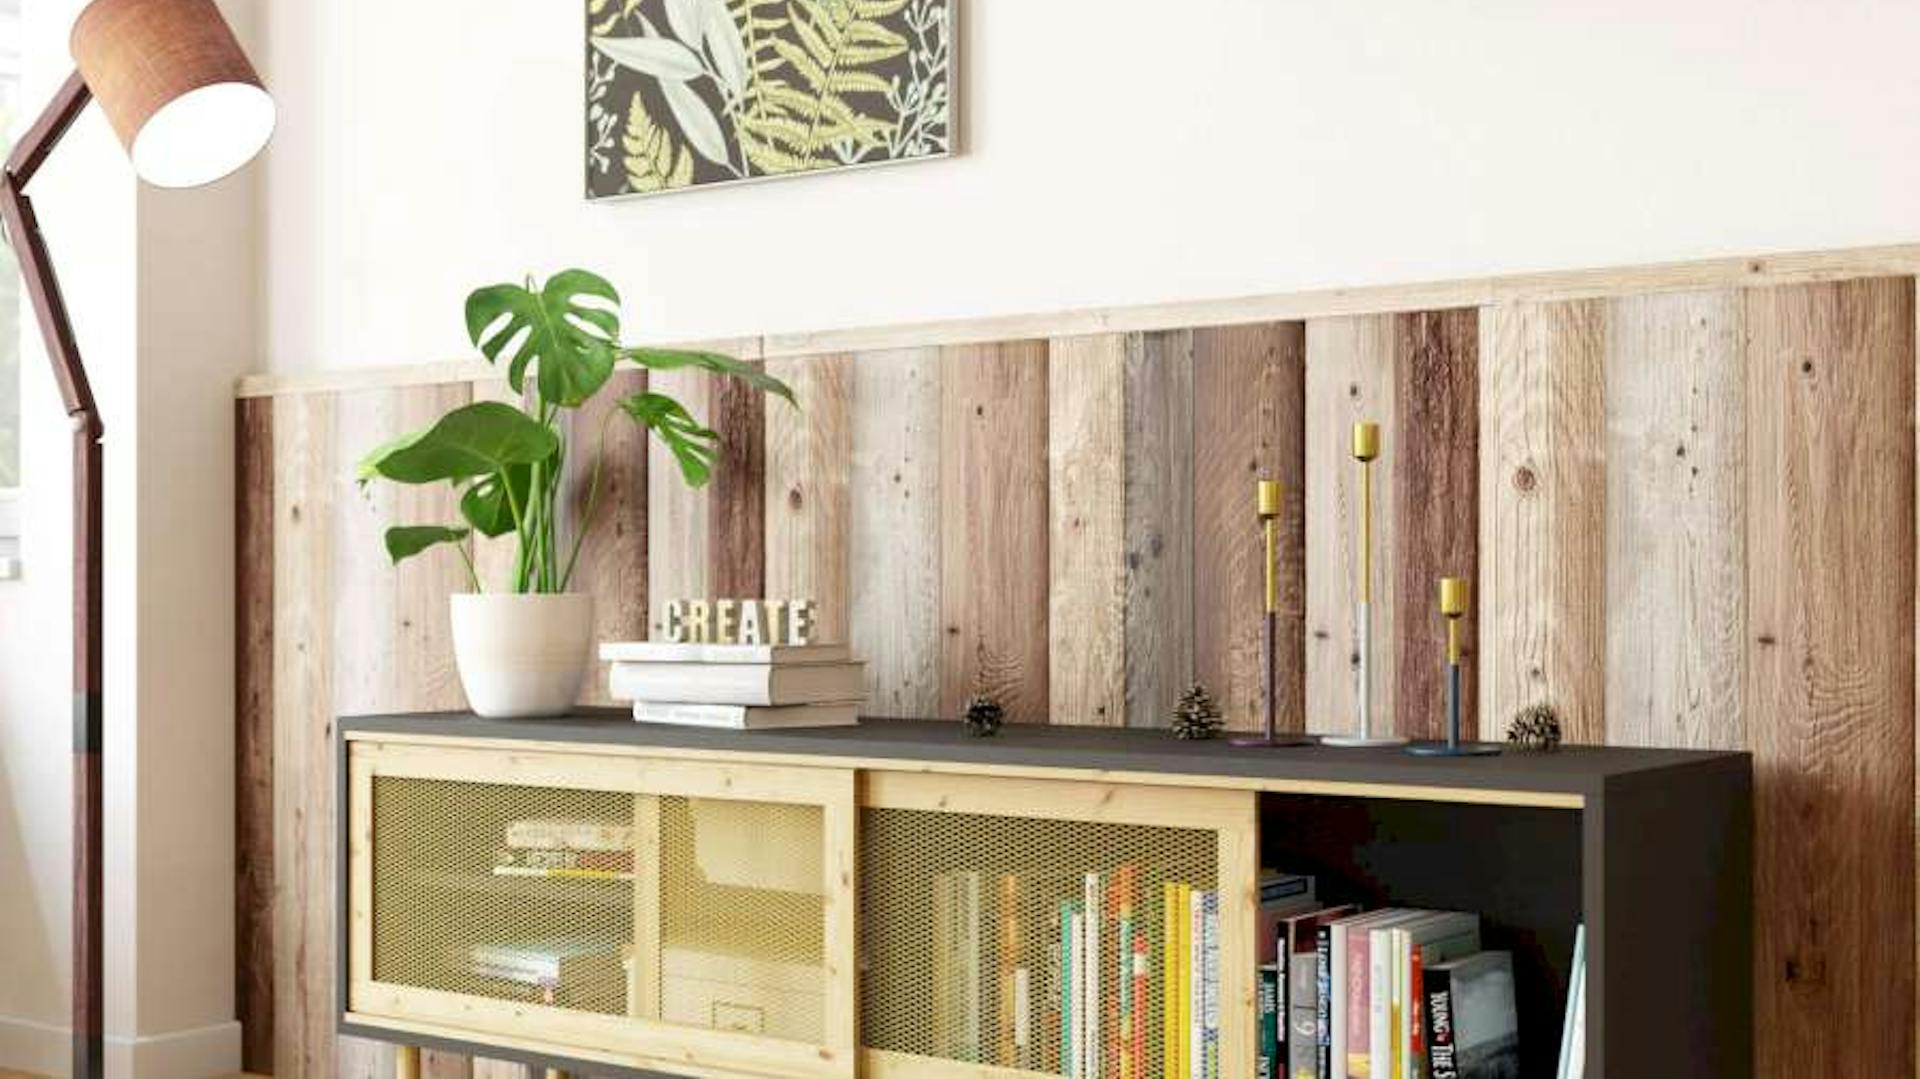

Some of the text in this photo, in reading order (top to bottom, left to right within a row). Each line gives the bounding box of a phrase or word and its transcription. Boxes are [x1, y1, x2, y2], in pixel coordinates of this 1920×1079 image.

[662, 598, 811, 648] CREATE
[1430, 989, 1451, 1034] YOUNG
[1430, 1044, 1455, 1069] THE
